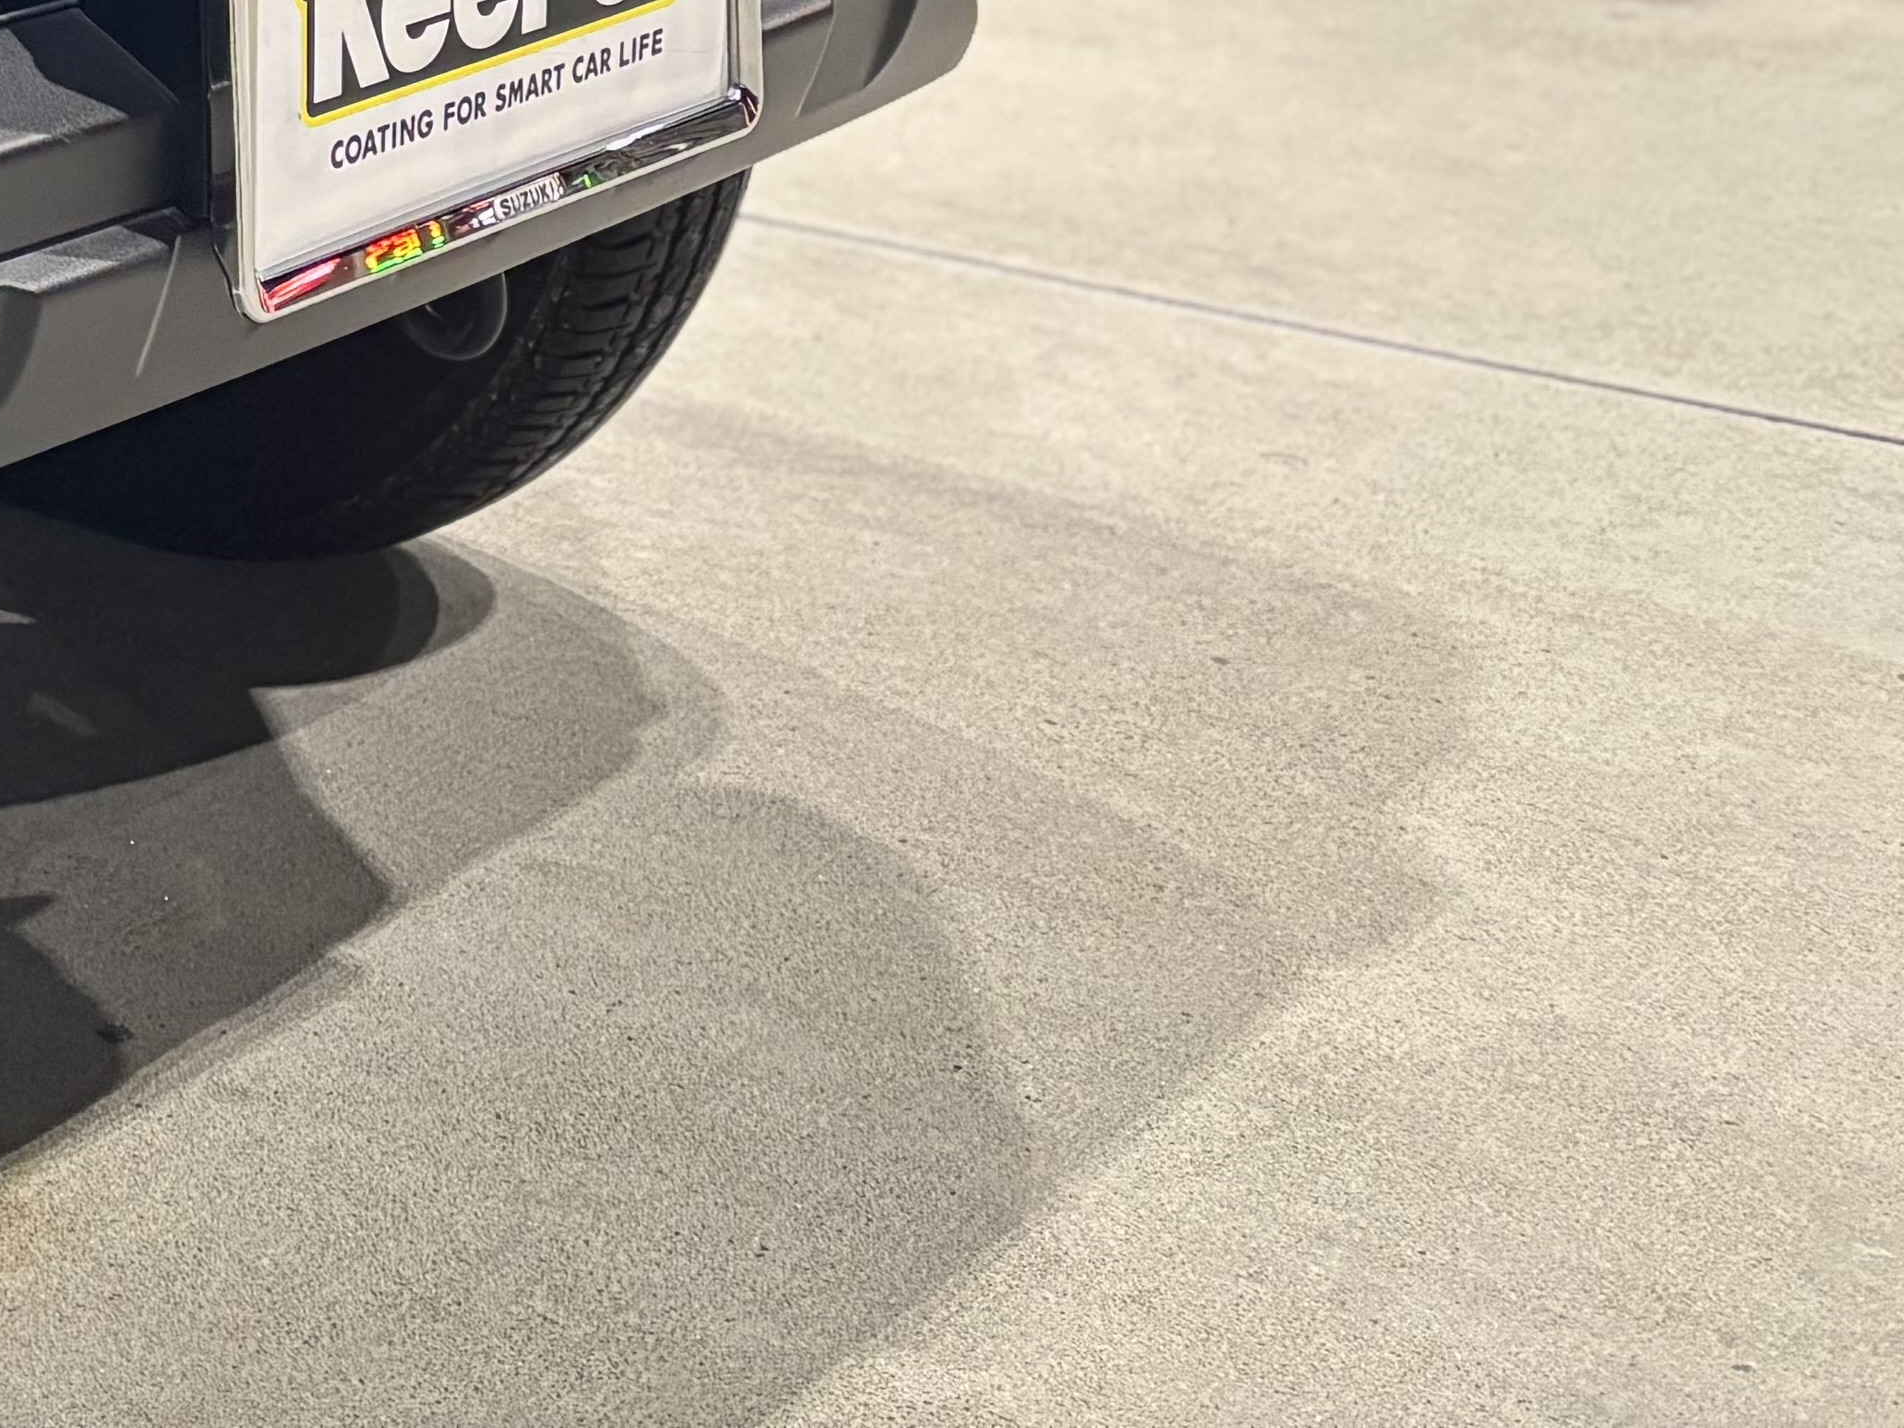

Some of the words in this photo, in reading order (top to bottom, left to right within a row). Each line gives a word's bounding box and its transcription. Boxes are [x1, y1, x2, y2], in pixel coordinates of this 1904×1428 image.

[330, 108, 435, 169] COATING
[442, 91, 487, 132] FOR
[494, 63, 566, 113] SMART
[571, 47, 612, 85] CAR
[618, 27, 665, 69] LIFE
[500, 178, 557, 219] SUZUKI
